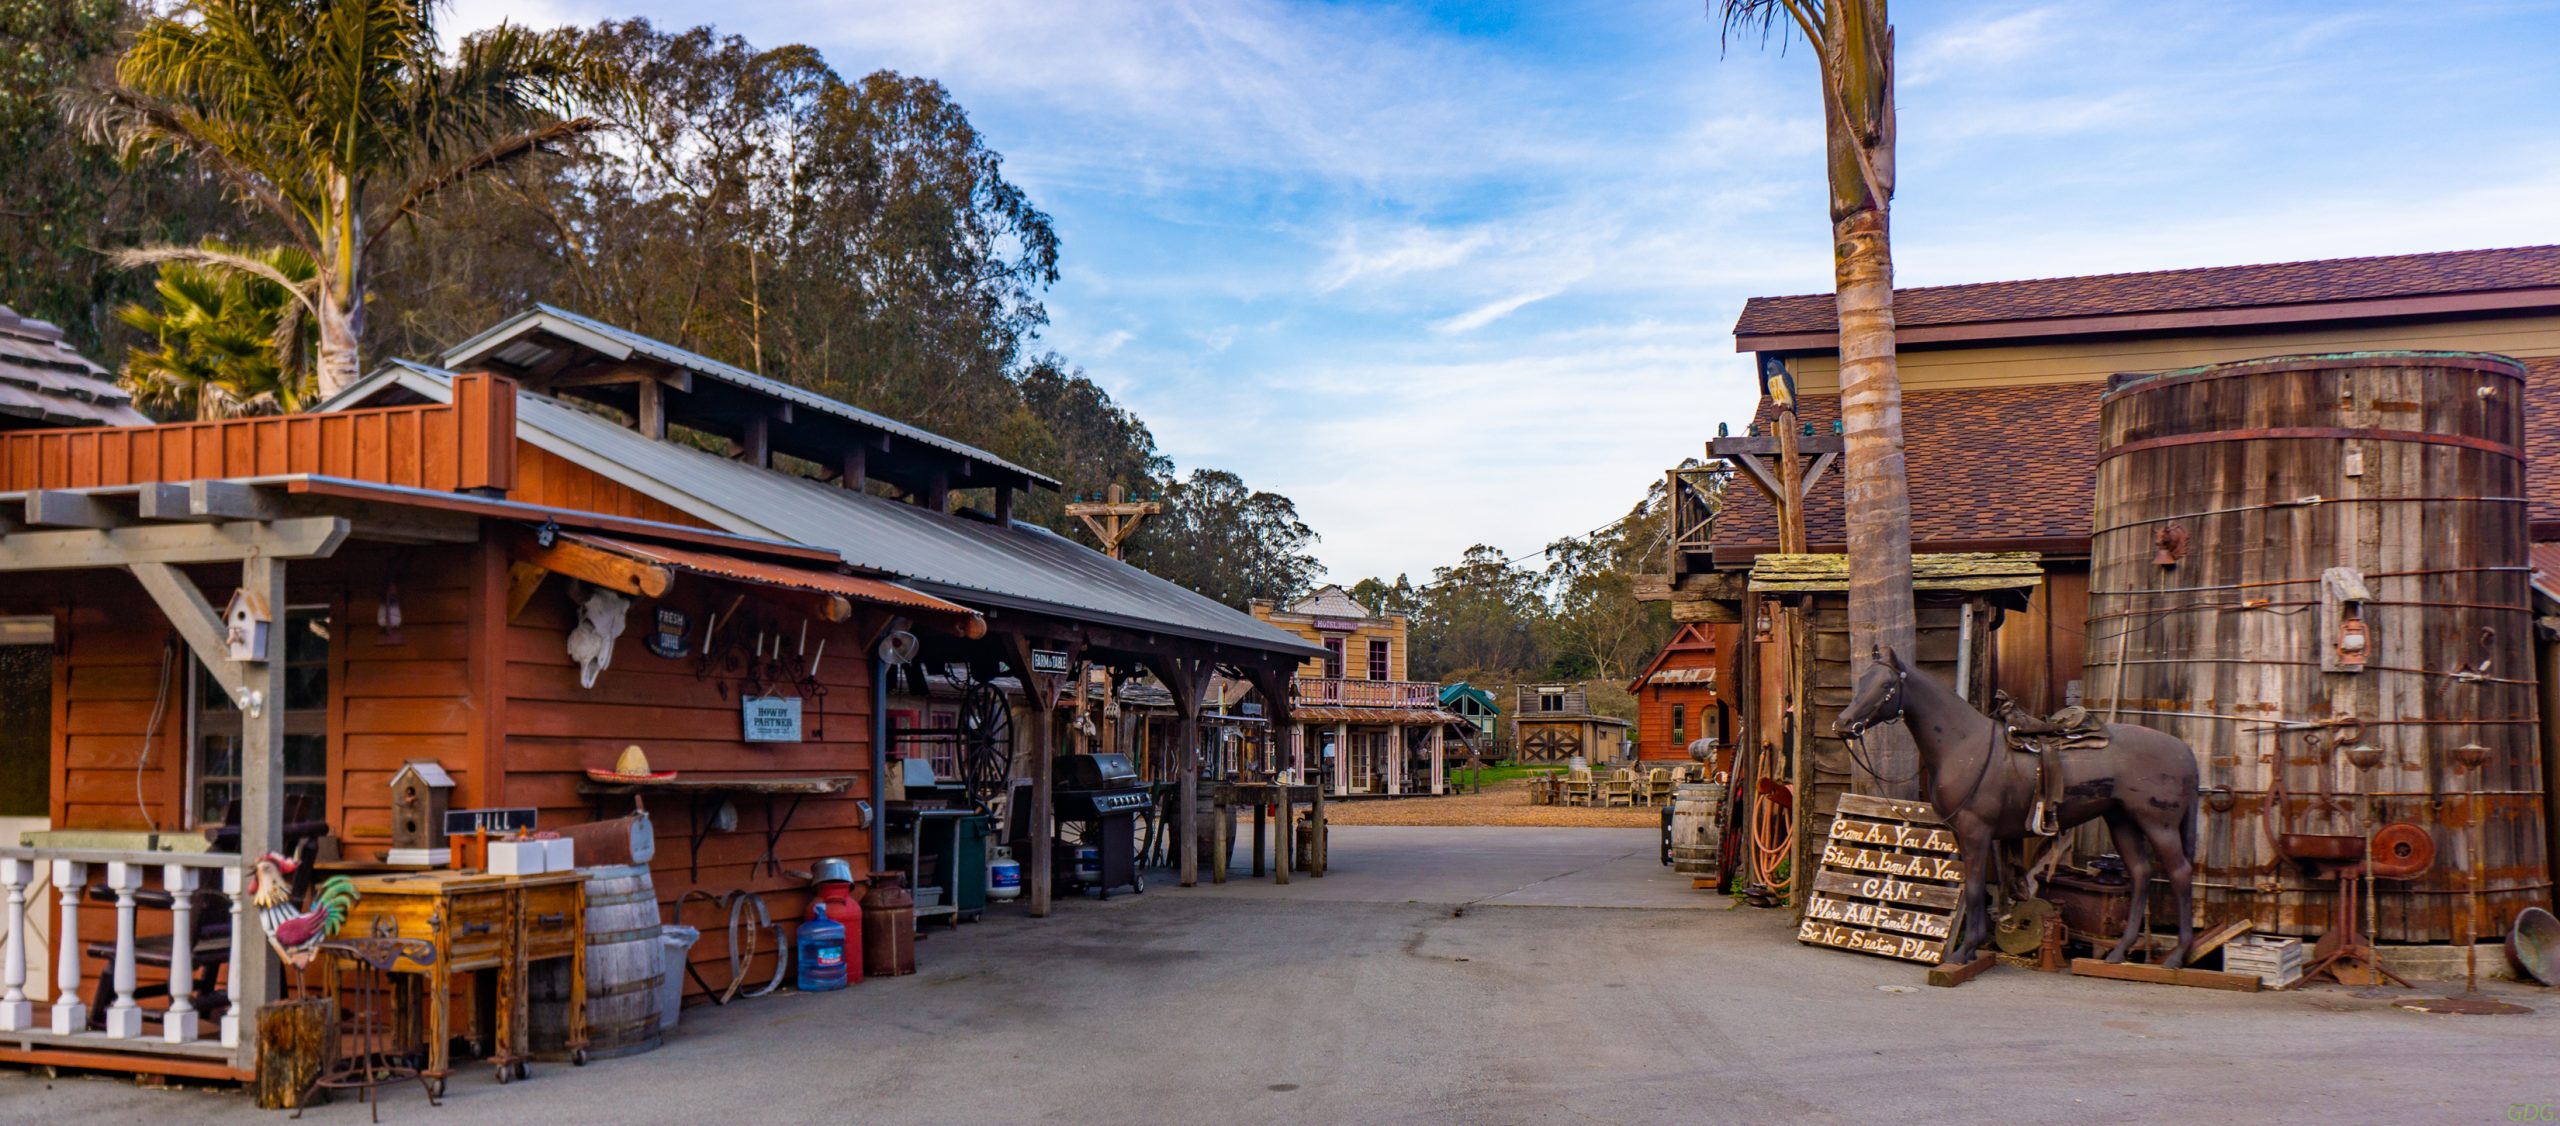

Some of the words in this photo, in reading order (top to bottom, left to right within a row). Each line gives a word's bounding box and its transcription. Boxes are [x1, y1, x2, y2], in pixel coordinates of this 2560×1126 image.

[659, 610, 684, 626] FRESH
[1035, 654, 1048, 668] FARM
[1052, 656, 1066, 669] TABLE
[753, 717, 793, 728] PARTNER
[758, 707, 788, 717] HOWDY
[475, 811, 510, 831] HILL
[1829, 820, 1864, 841] Come
[1864, 823, 1888, 844] As
[1894, 825, 1919, 847] You
[1821, 845, 1854, 868] Stay
[1853, 849, 1876, 870] As
[1878, 853, 1906, 875] Long
[1905, 856, 1930, 877] As
[1933, 858, 1961, 880] You
[1862, 878, 1913, 900] CAN
[1842, 902, 1872, 926] All
[1871, 907, 1911, 931] Family
[1798, 921, 1820, 940] So
[1822, 926, 1847, 945] No
[1848, 930, 1897, 955] Seating
[1897, 937, 1940, 962] Plan
